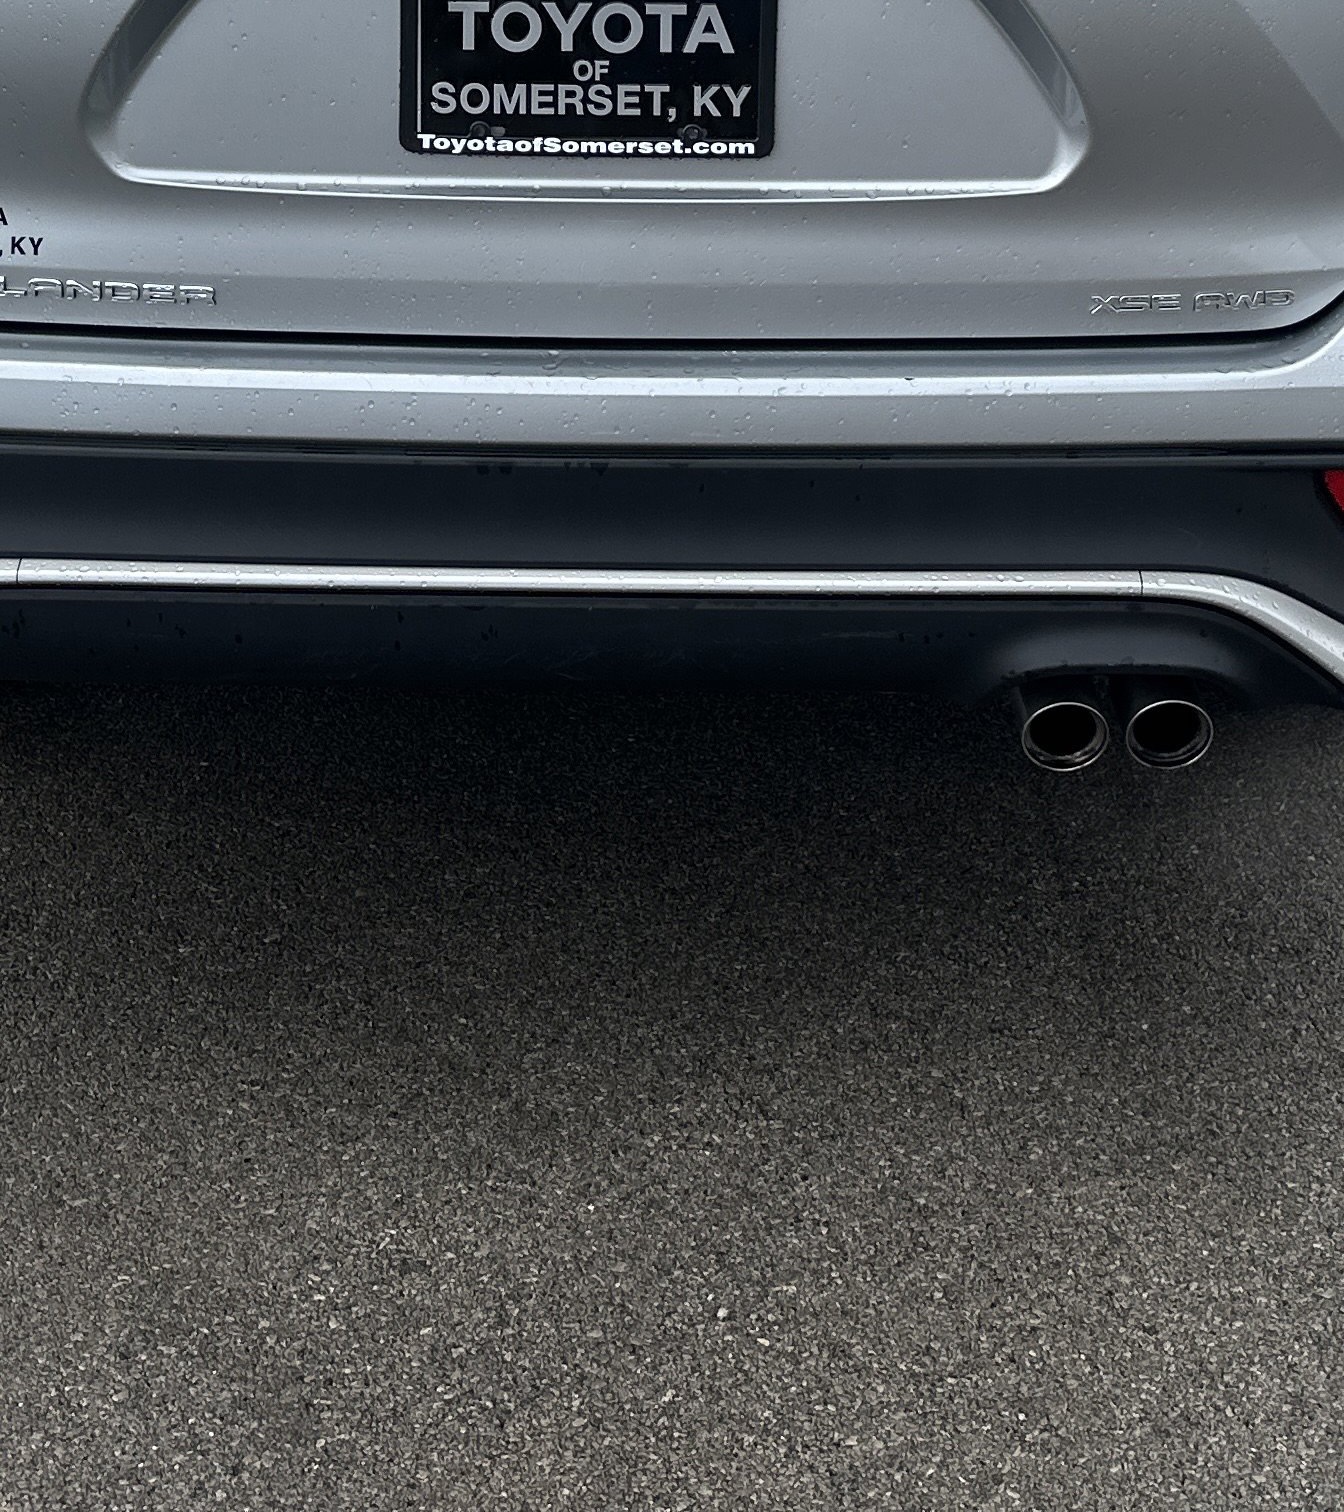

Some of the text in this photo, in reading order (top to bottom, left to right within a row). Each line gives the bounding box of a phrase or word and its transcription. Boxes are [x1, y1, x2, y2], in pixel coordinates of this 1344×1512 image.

[448, 1, 735, 54] TOYOTA
[573, 60, 610, 81] OF
[430, 82, 752, 122] SOMERSET, KY
[417, 134, 756, 155] ToyotaofSomerset.com
[10, 236, 44, 256] KY
[1091, 289, 1297, 314] XSE AWD
